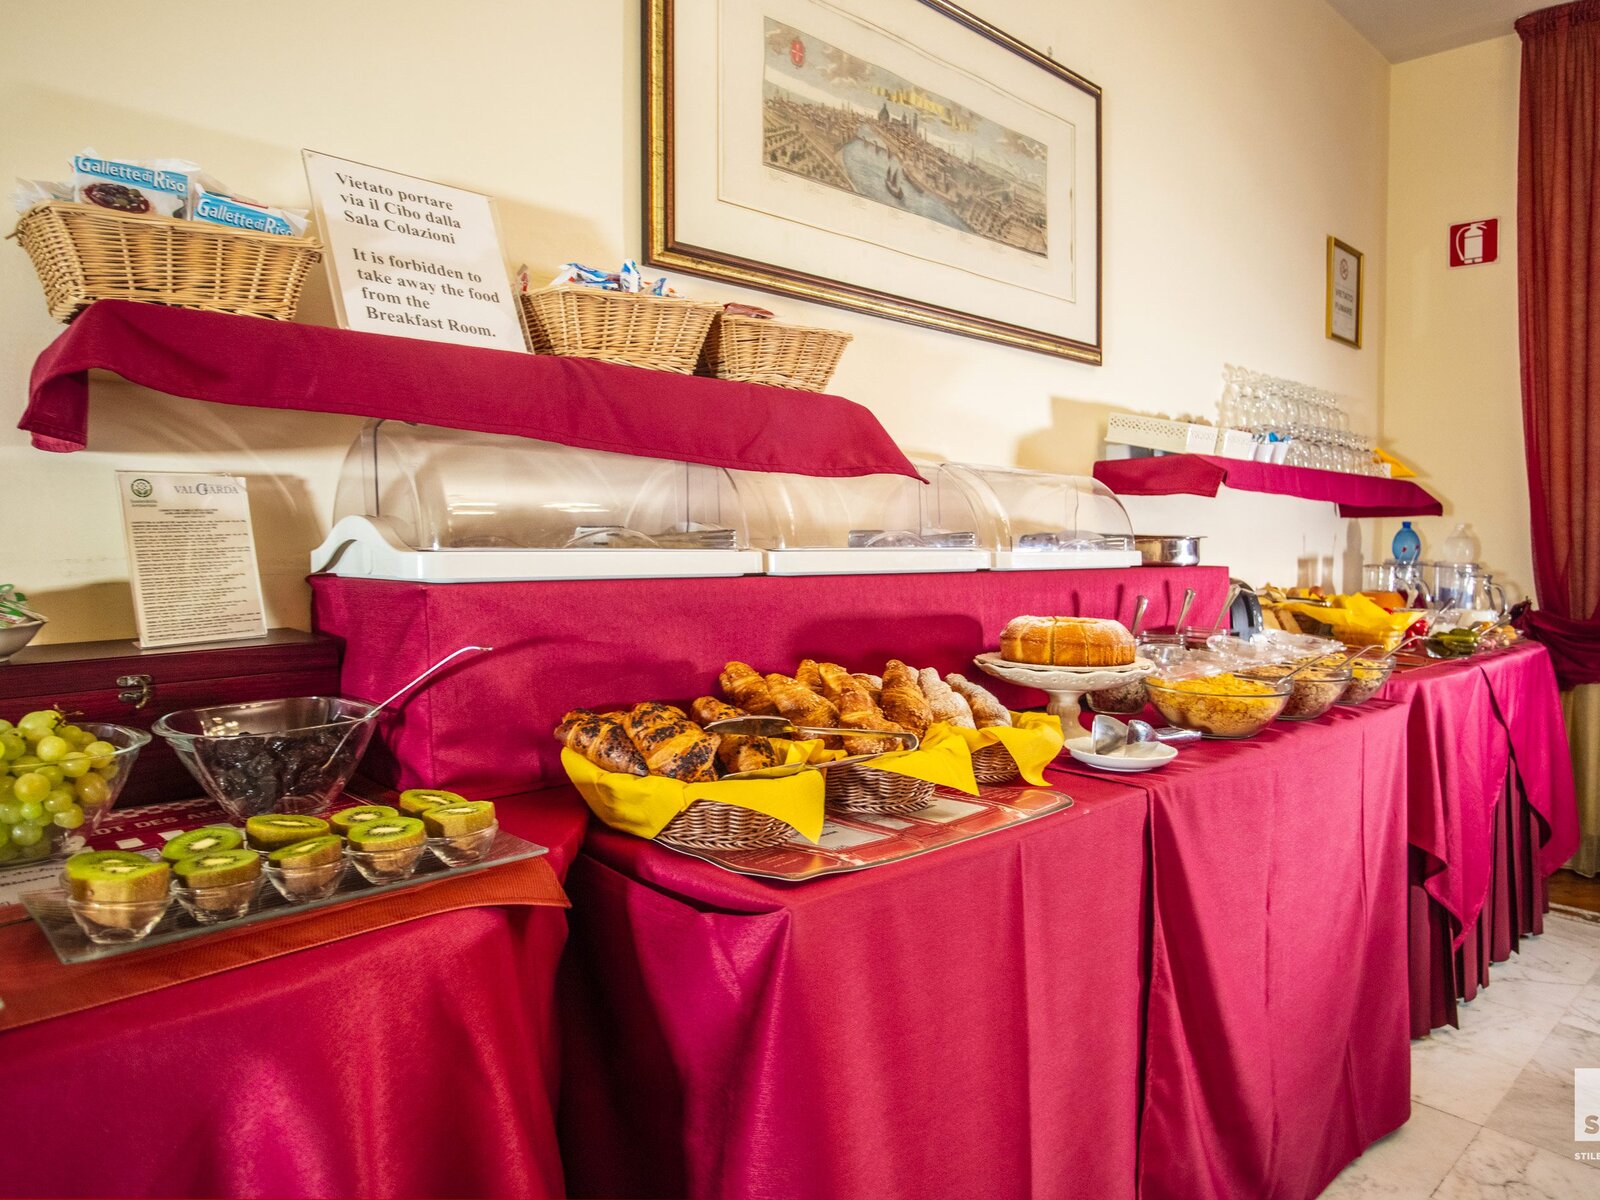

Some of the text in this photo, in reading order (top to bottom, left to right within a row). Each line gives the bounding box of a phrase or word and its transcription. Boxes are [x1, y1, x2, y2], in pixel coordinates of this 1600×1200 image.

[77, 156, 186, 193] Gallette di Riso
[335, 172, 453, 211] Vietato portare
[196, 199, 293, 236] Gallette di Riso
[340, 193, 462, 229] via il Cibo dalla
[343, 210, 456, 245] Sala Colazioni
[352, 247, 482, 283] It is forbidden to
[356, 267, 501, 304] take away the food
[361, 286, 431, 310] from the
[365, 305, 497, 338] Breakfast Room.
